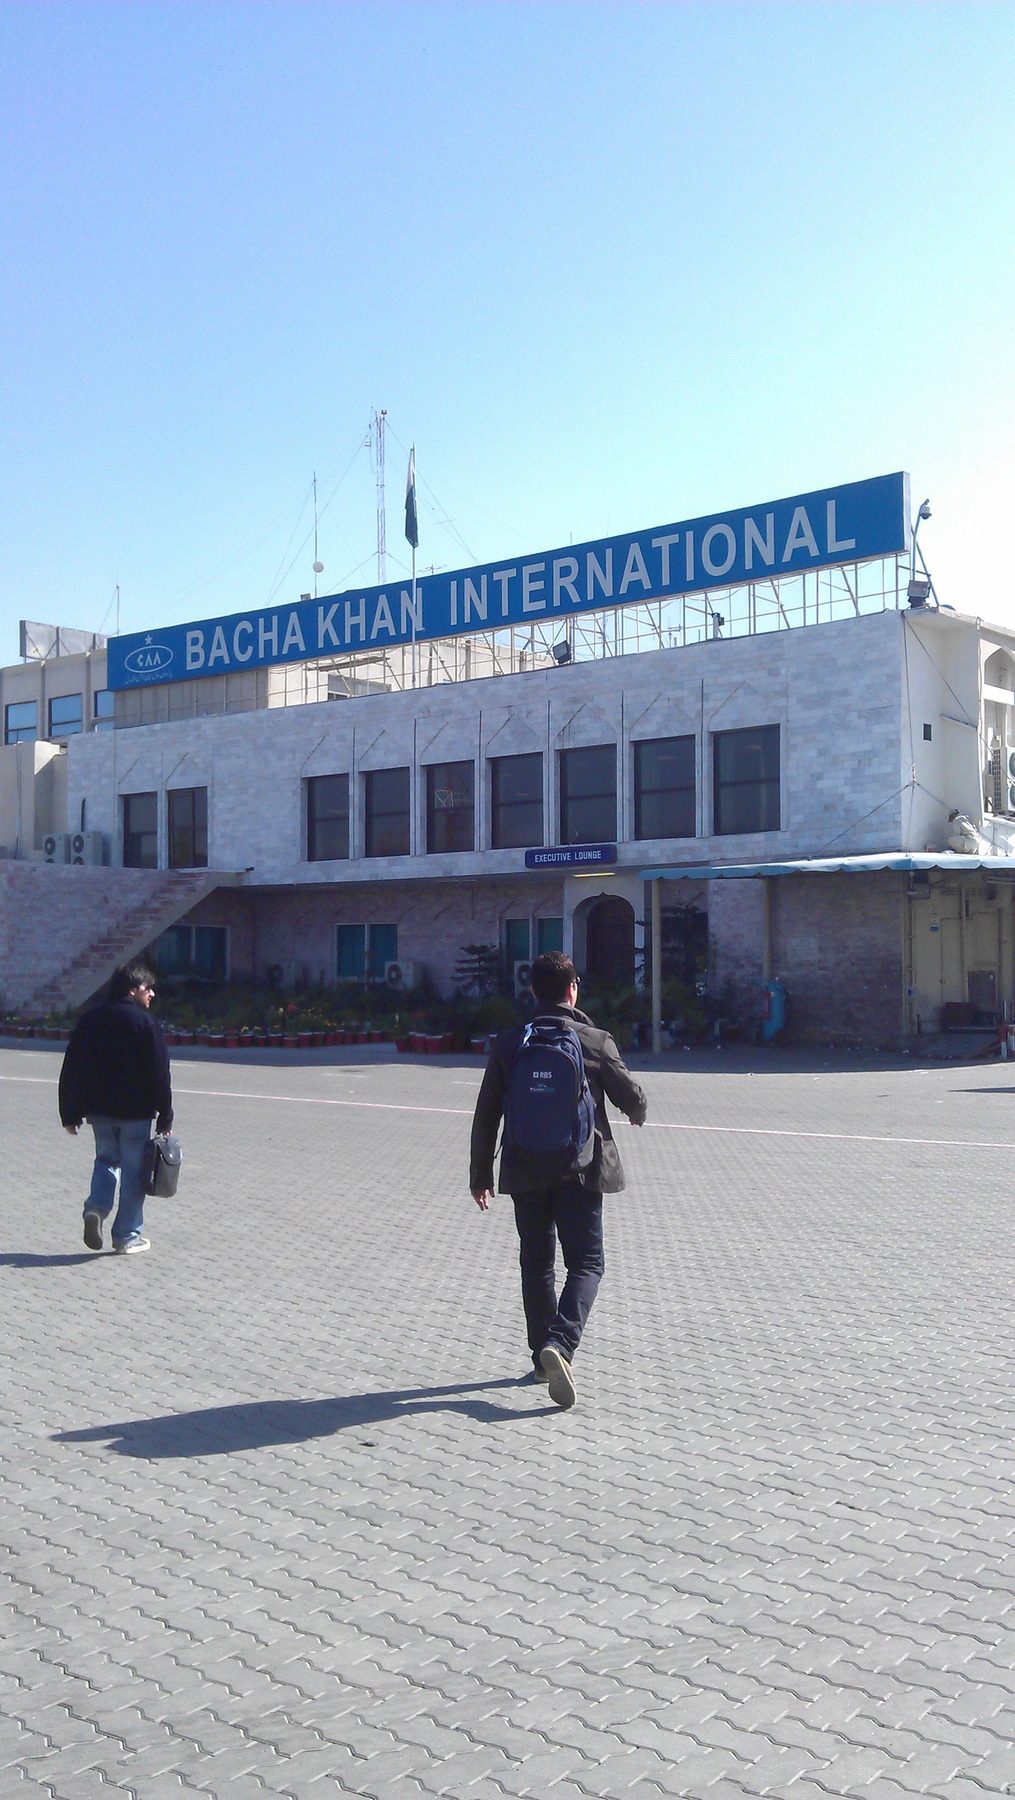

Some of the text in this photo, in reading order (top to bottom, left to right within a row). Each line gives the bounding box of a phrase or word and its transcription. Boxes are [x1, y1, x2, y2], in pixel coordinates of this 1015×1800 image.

[186, 499, 856, 670] BACHA KHAN INTERNATIONAL
[534, 850, 602, 863] EXECUTIVE LOUNGE
[540, 1071, 552, 1079] RBS
